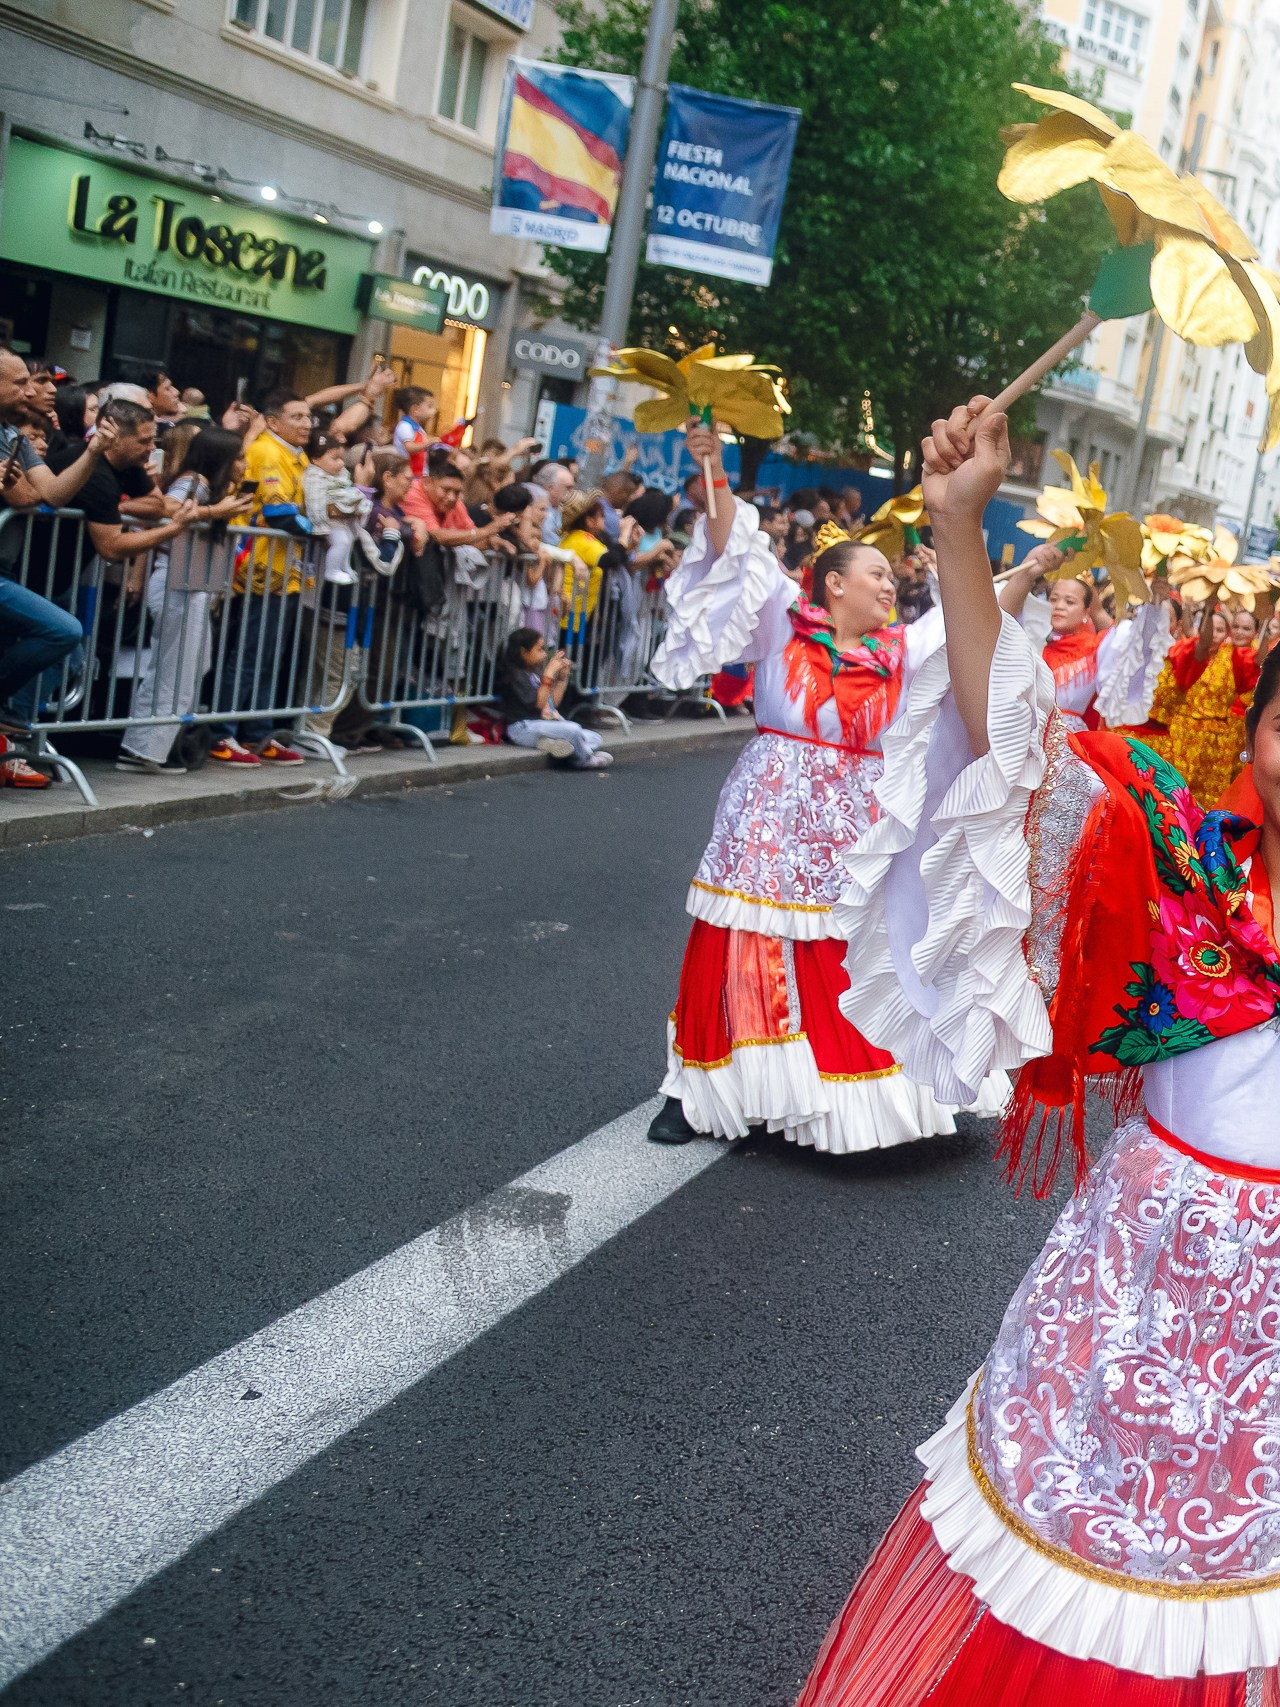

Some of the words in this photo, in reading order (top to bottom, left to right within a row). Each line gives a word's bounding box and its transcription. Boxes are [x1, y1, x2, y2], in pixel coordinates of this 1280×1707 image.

[667, 140, 724, 168] FIESTA
[663, 161, 754, 197] NACIONAL
[69, 174, 138, 245] La
[152, 194, 328, 291] Toscana
[524, 221, 579, 242] MADRID
[657, 204, 675, 225] 12
[677, 208, 763, 247] OCTUBRE
[124, 258, 177, 290] Italian
[180, 270, 271, 310] Restaurant
[514, 339, 581, 369] CODO
